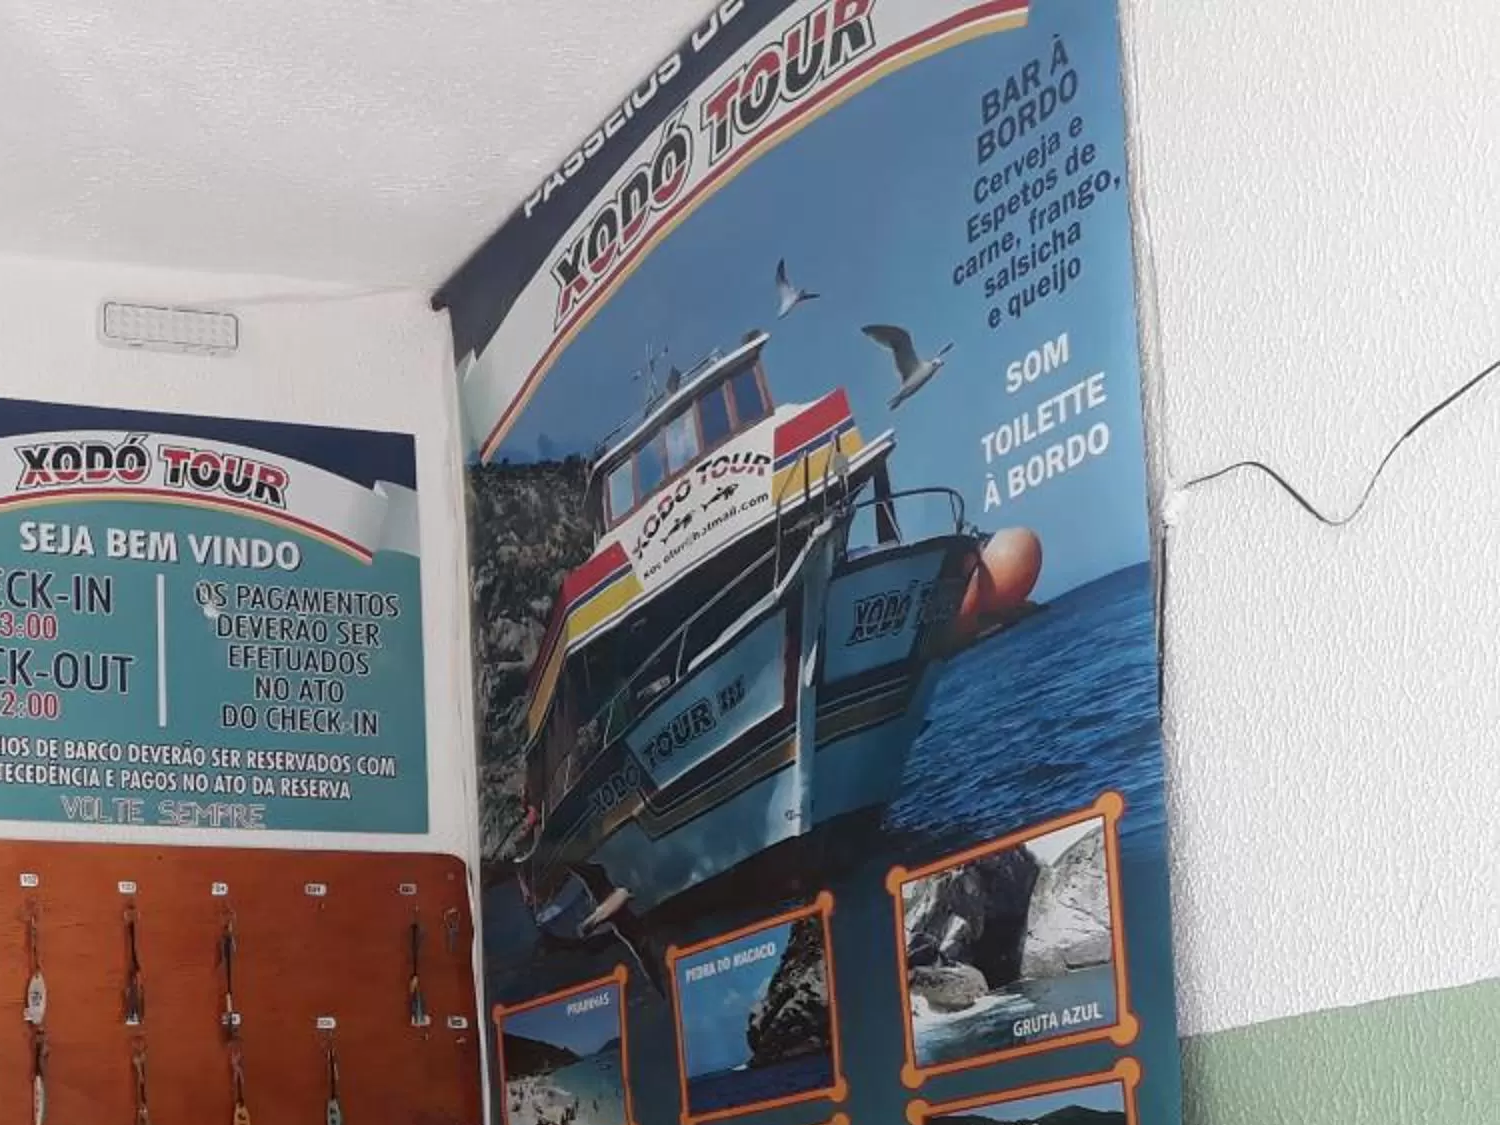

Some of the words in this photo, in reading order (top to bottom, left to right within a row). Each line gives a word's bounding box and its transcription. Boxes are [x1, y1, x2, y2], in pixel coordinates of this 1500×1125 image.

[981, 58, 1041, 125] BAR
[1050, 33, 1069, 77] À
[977, 68, 1078, 166] BORDO
[552, 101, 693, 332] XODÓ
[700, 0, 876, 167] TOUR
[973, 130, 1061, 204] Cerveja
[1069, 116, 1083, 138] e
[966, 167, 1058, 243] Espetos
[1065, 143, 1096, 176] de
[952, 230, 1021, 286] carne,
[1028, 169, 1120, 235] frango,
[985, 221, 1081, 298] salsicha
[988, 307, 1002, 328] e
[1008, 256, 1081, 319] queijo
[1006, 332, 1069, 392] SOM
[981, 372, 1107, 464] TOILETTE
[14, 434, 151, 490] XODÓ
[159, 444, 291, 509] TOUR
[695, 451, 773, 484] TOUR
[984, 472, 1002, 513] À
[1008, 421, 1109, 499] BORDO
[19, 521, 96, 557] SEJA
[106, 527, 180, 563] BEM
[187, 533, 302, 571] VINDO
[195, 580, 228, 607] OS
[236, 584, 400, 618] PAGAMENTOS
[216, 612, 328, 645] DEVERÃO
[336, 622, 381, 648] SER
[228, 643, 371, 677] EFETUADOS
[254, 675, 290, 703] NO
[298, 678, 345, 705] ATO
[222, 704, 259, 731] DO
[643, 697, 717, 768] TOUR
[36, 738, 57, 760] DE
[64, 740, 123, 763] BARCO
[128, 741, 206, 768] DEVERÃO
[212, 748, 242, 769] SER
[247, 750, 351, 775] RESERVADOS
[356, 755, 397, 777] COM
[106, 769, 115, 788] E
[120, 769, 178, 791] PAGOS
[182, 774, 209, 793] NO
[213, 774, 247, 796] ATO
[252, 776, 276, 797] DA
[280, 779, 352, 800] RESERVA
[60, 795, 145, 824] VOLTE
[157, 799, 268, 830] SEMPRE
[1013, 1011, 1059, 1037] GRUTA
[1061, 1001, 1104, 1026] AZUL
